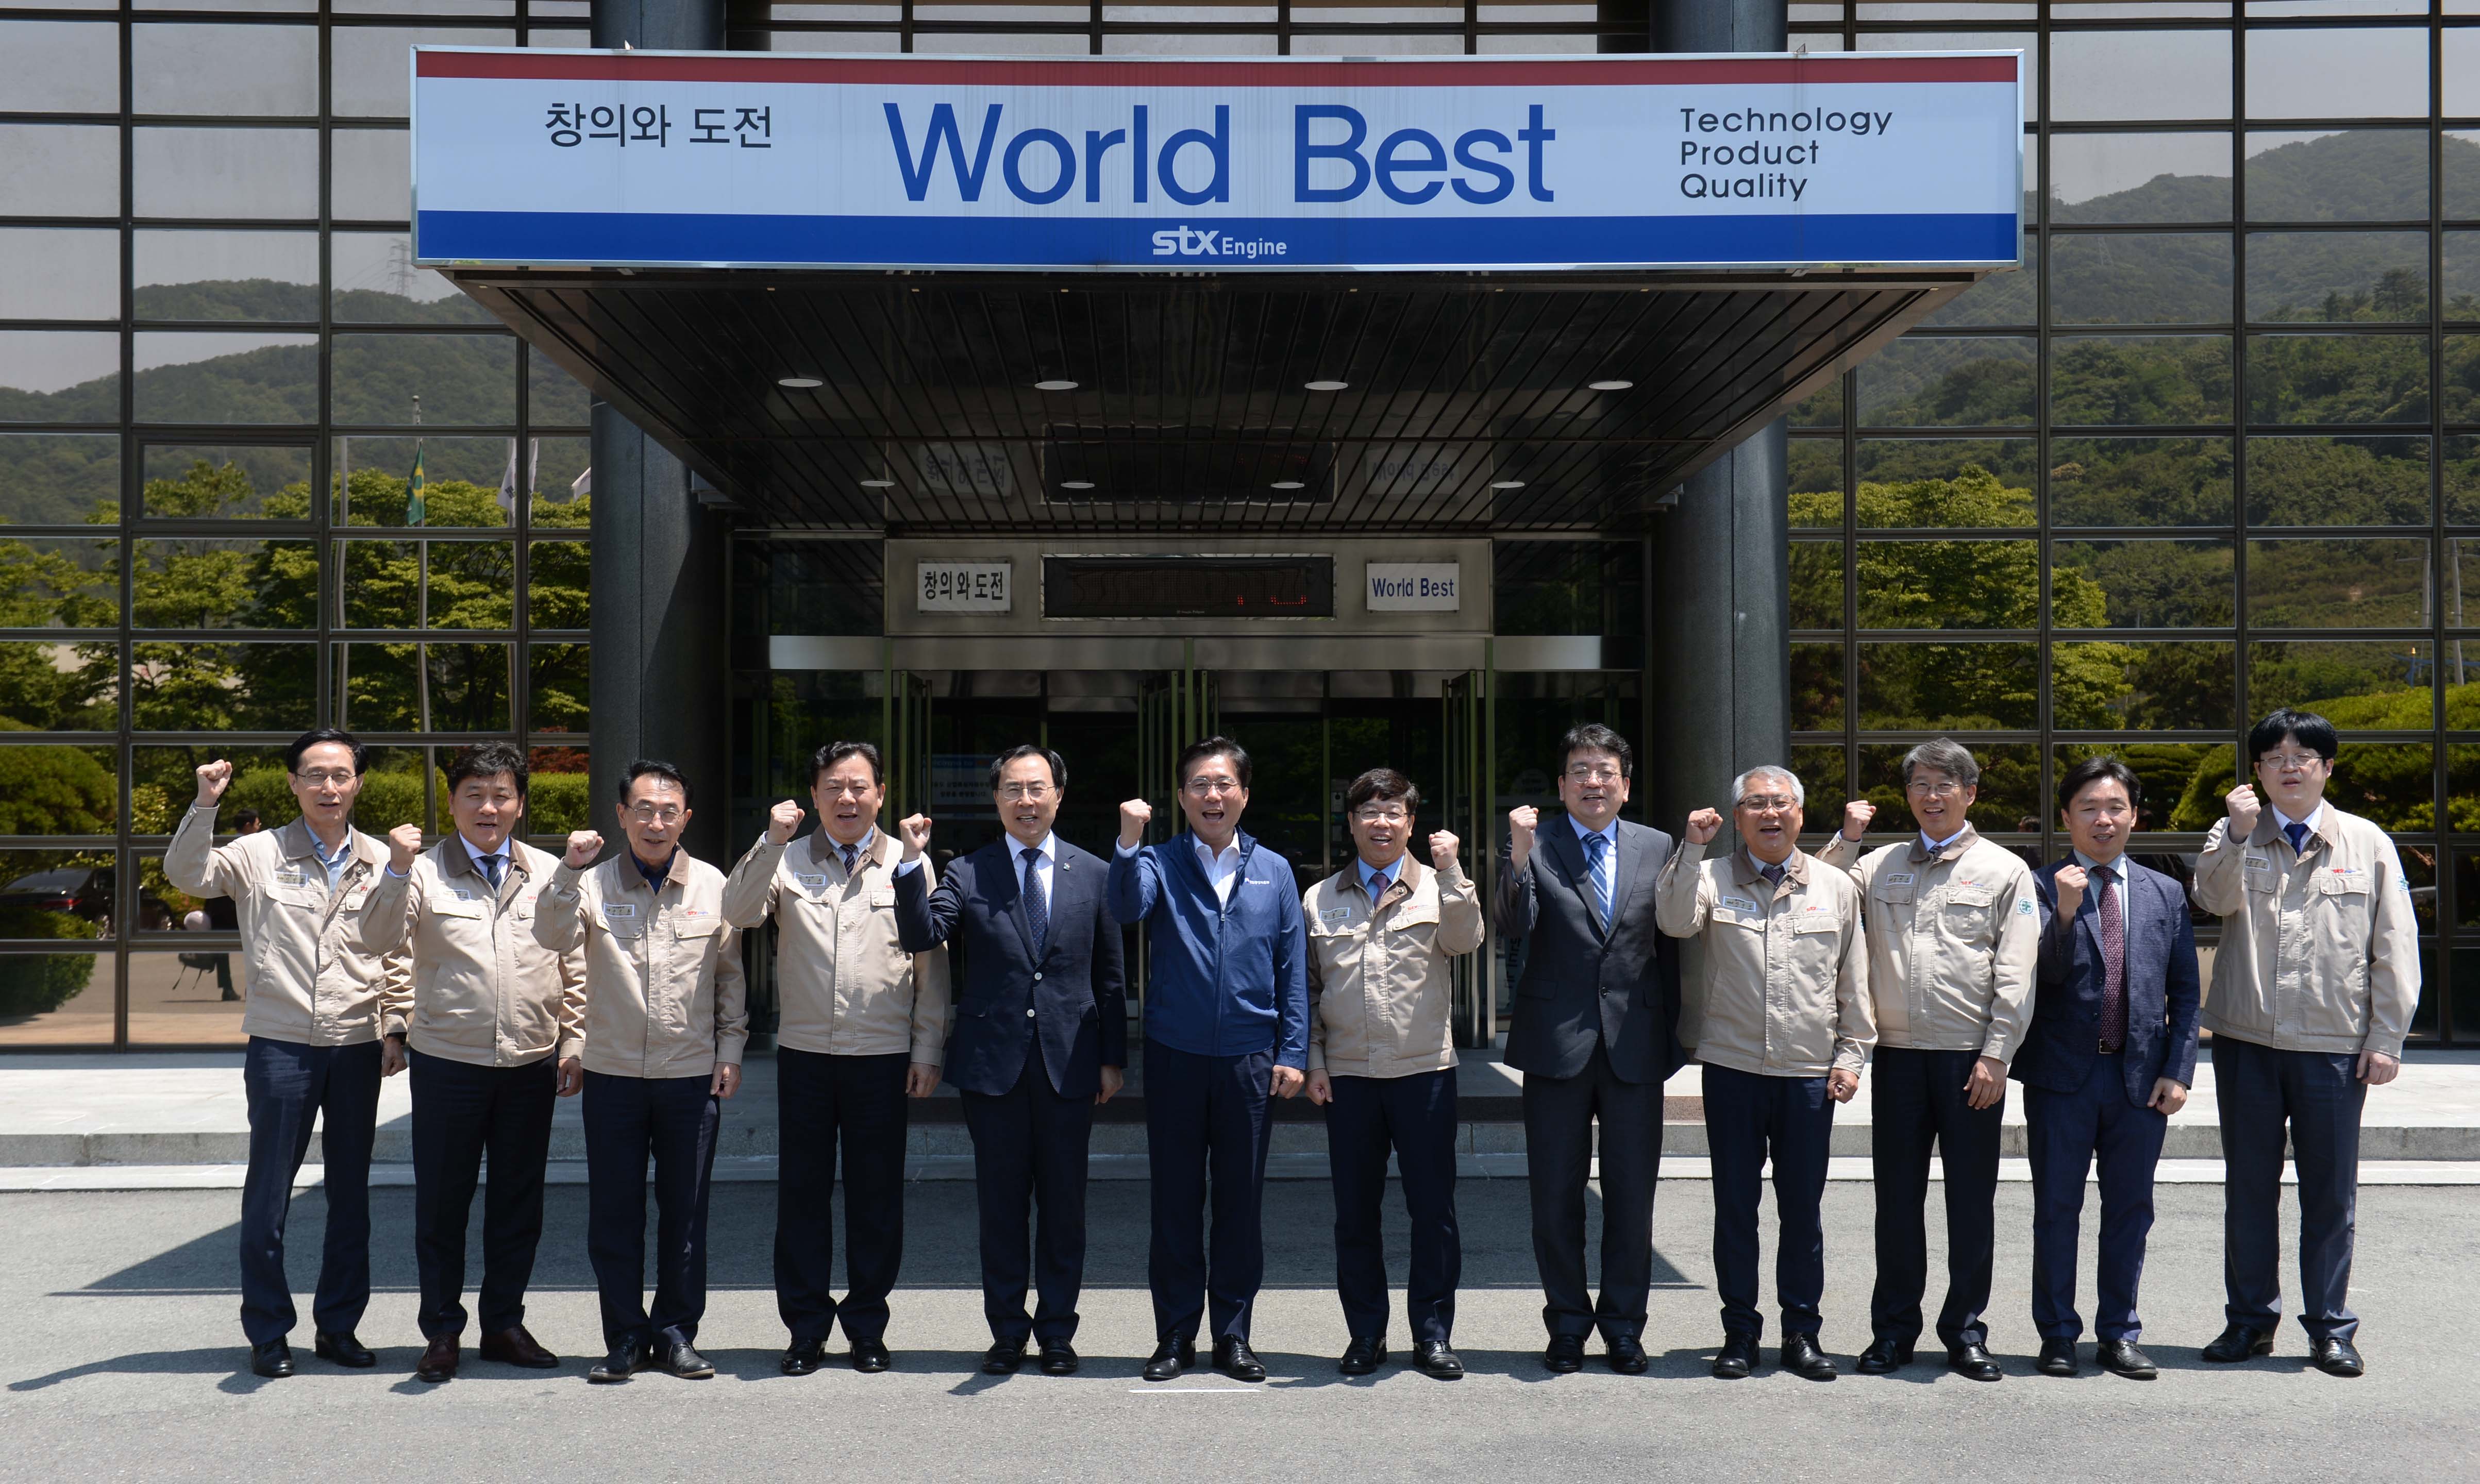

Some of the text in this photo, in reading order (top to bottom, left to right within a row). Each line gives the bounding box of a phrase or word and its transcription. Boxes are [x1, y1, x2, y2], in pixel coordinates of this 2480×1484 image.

[545, 103, 772, 149] 창의와 도전
[1680, 107, 1893, 136] Technology
[883, 103, 1556, 206] World Best
[1681, 140, 1819, 166] Product
[1681, 173, 1808, 202] Quality
[1152, 225, 1287, 259] stx Engine
[1372, 578, 1455, 597] World Best
